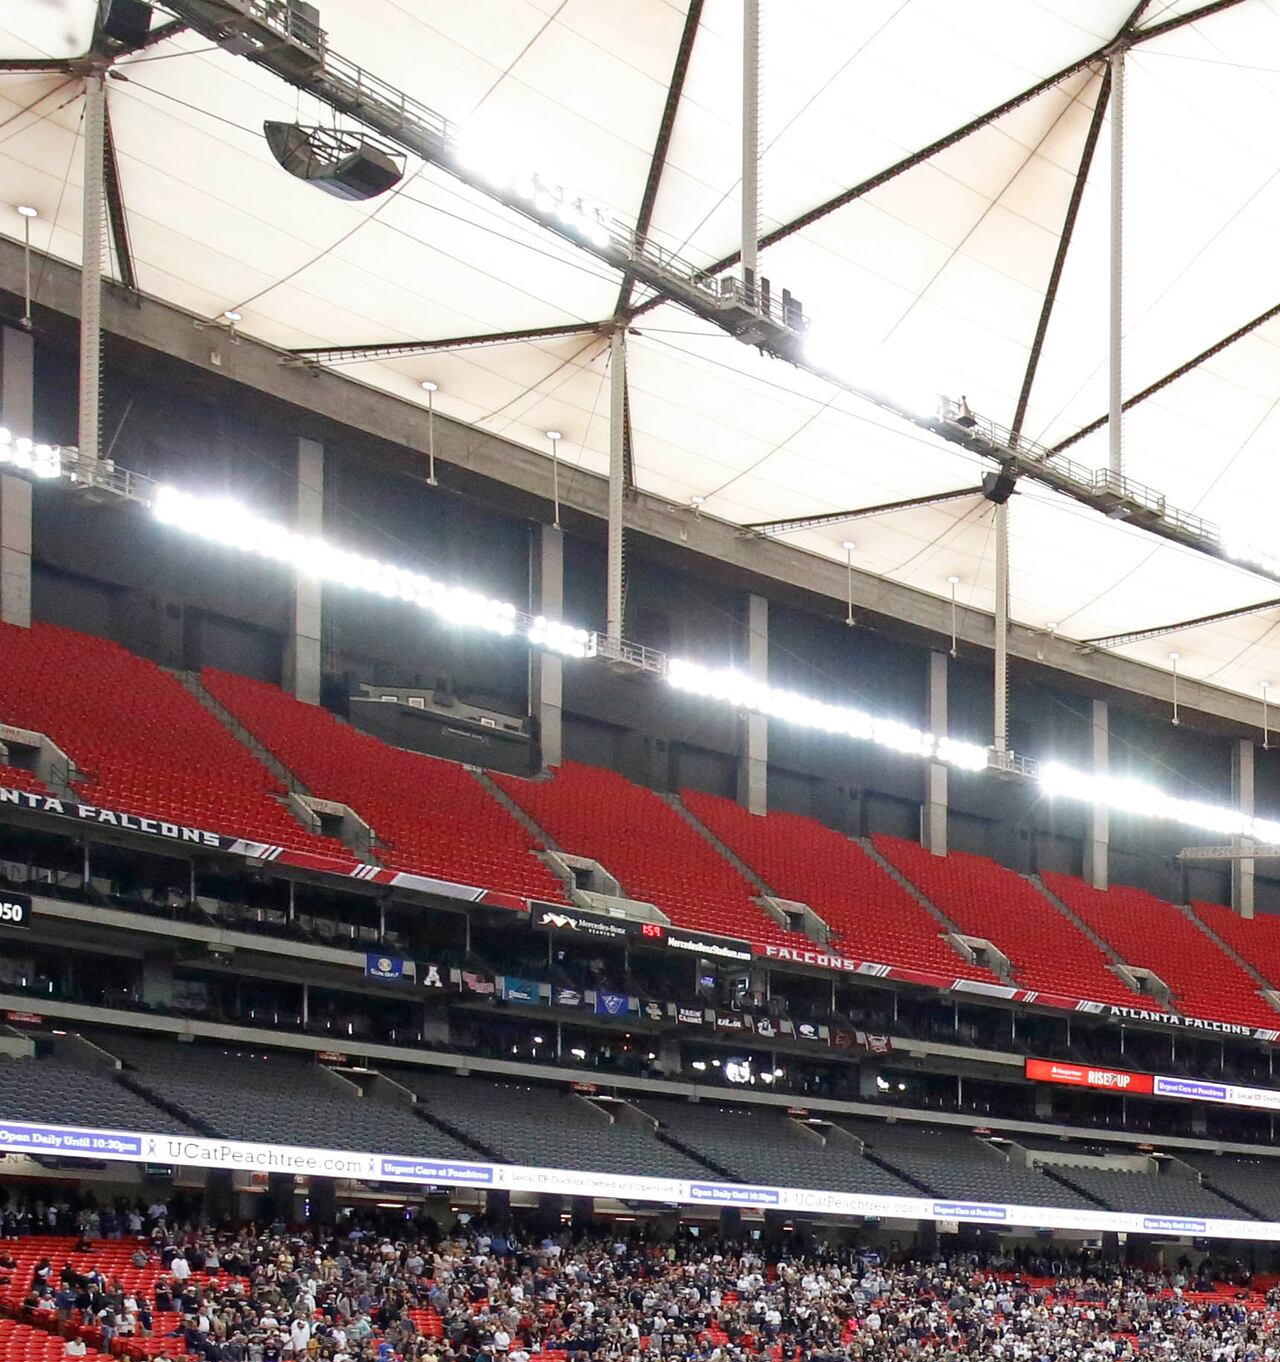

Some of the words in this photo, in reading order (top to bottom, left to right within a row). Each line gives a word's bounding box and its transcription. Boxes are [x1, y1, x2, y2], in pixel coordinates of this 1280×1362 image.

[78, 804, 220, 847] FALCONS
[578, 919, 627, 935] Mercedes-Benz
[765, 945, 856, 971] FALCONS
[1110, 1004, 1180, 1025] ATLANTA
[1185, 1016, 1251, 1036] FALCONS
[1088, 1070, 1109, 1086] RISE
[1117, 1074, 1131, 1088] UP
[0, 1131, 30, 1144] Open
[31, 1133, 62, 1147] Daily
[64, 1136, 90, 1147] Until
[92, 1138, 137, 1153] 10:30pm
[168, 1140, 362, 1173] UCatPeachtree.com
[384, 1162, 414, 1177] Urgent
[415, 1164, 438, 1176] Care
[448, 1167, 490, 1181] Peachtree
